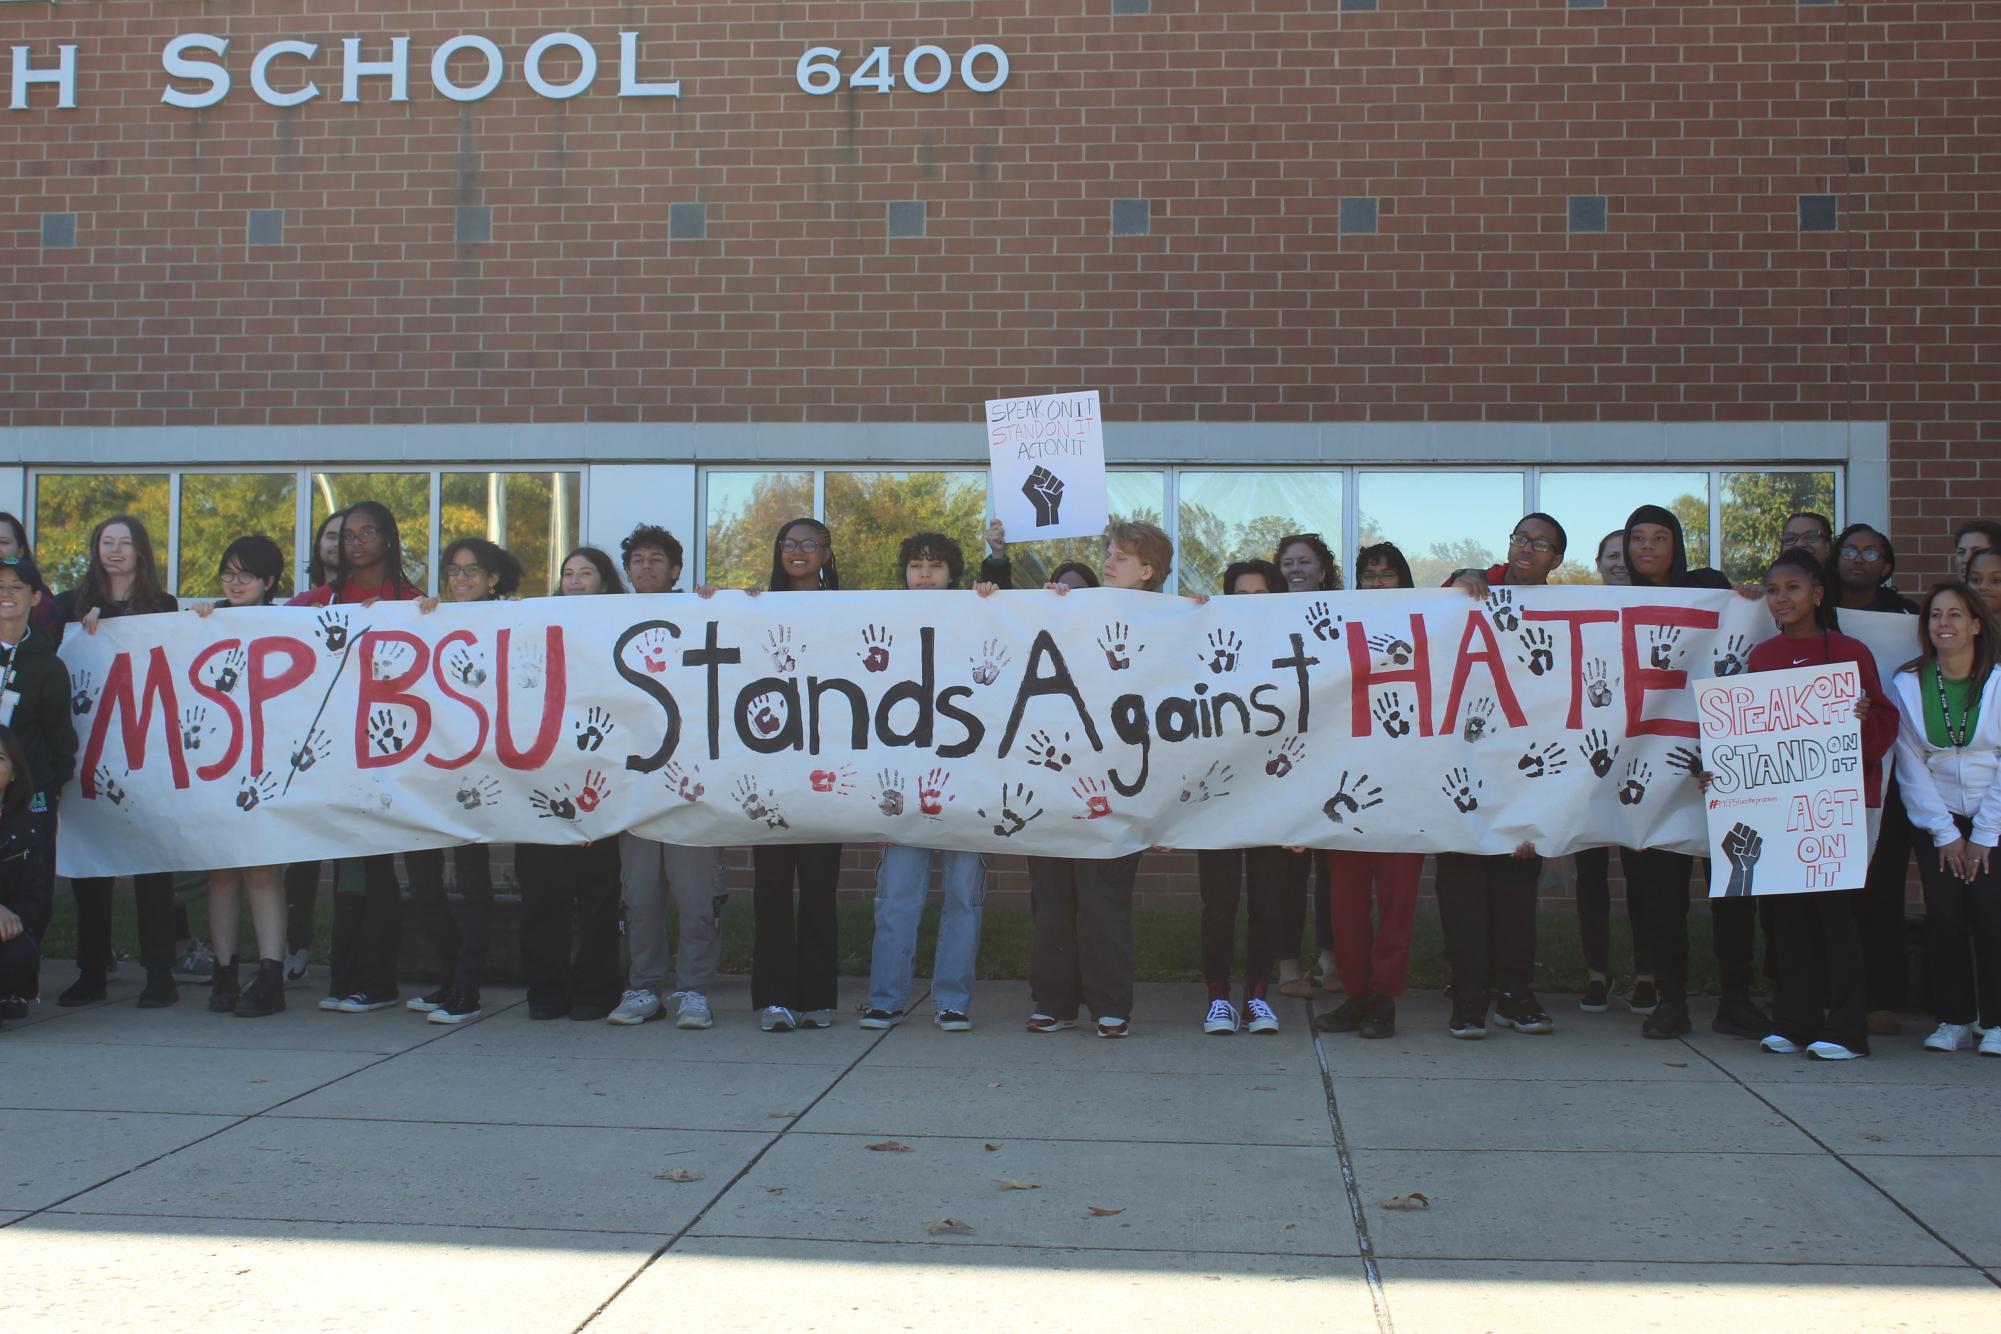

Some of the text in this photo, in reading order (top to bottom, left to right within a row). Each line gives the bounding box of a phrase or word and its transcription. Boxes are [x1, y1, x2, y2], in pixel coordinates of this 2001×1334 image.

[160, 31, 682, 109] SCHOOL
[795, 43, 1010, 96] 6400
[992, 397, 1096, 422] SPEAK ON IT
[1075, 417, 1093, 435] IT
[1071, 439, 1086, 456] IT
[80, 605, 1720, 800] MSP/BSU Stands Against HATE
[1699, 672, 1855, 739] SPEAK ON
[1822, 700, 1850, 726] IT
[1711, 733, 1858, 794] STAND ON
[1832, 757, 1857, 773] IT
[1786, 789, 1859, 832] ACT
[1797, 834, 1847, 864] ON
[1806, 862, 1841, 888] IT
